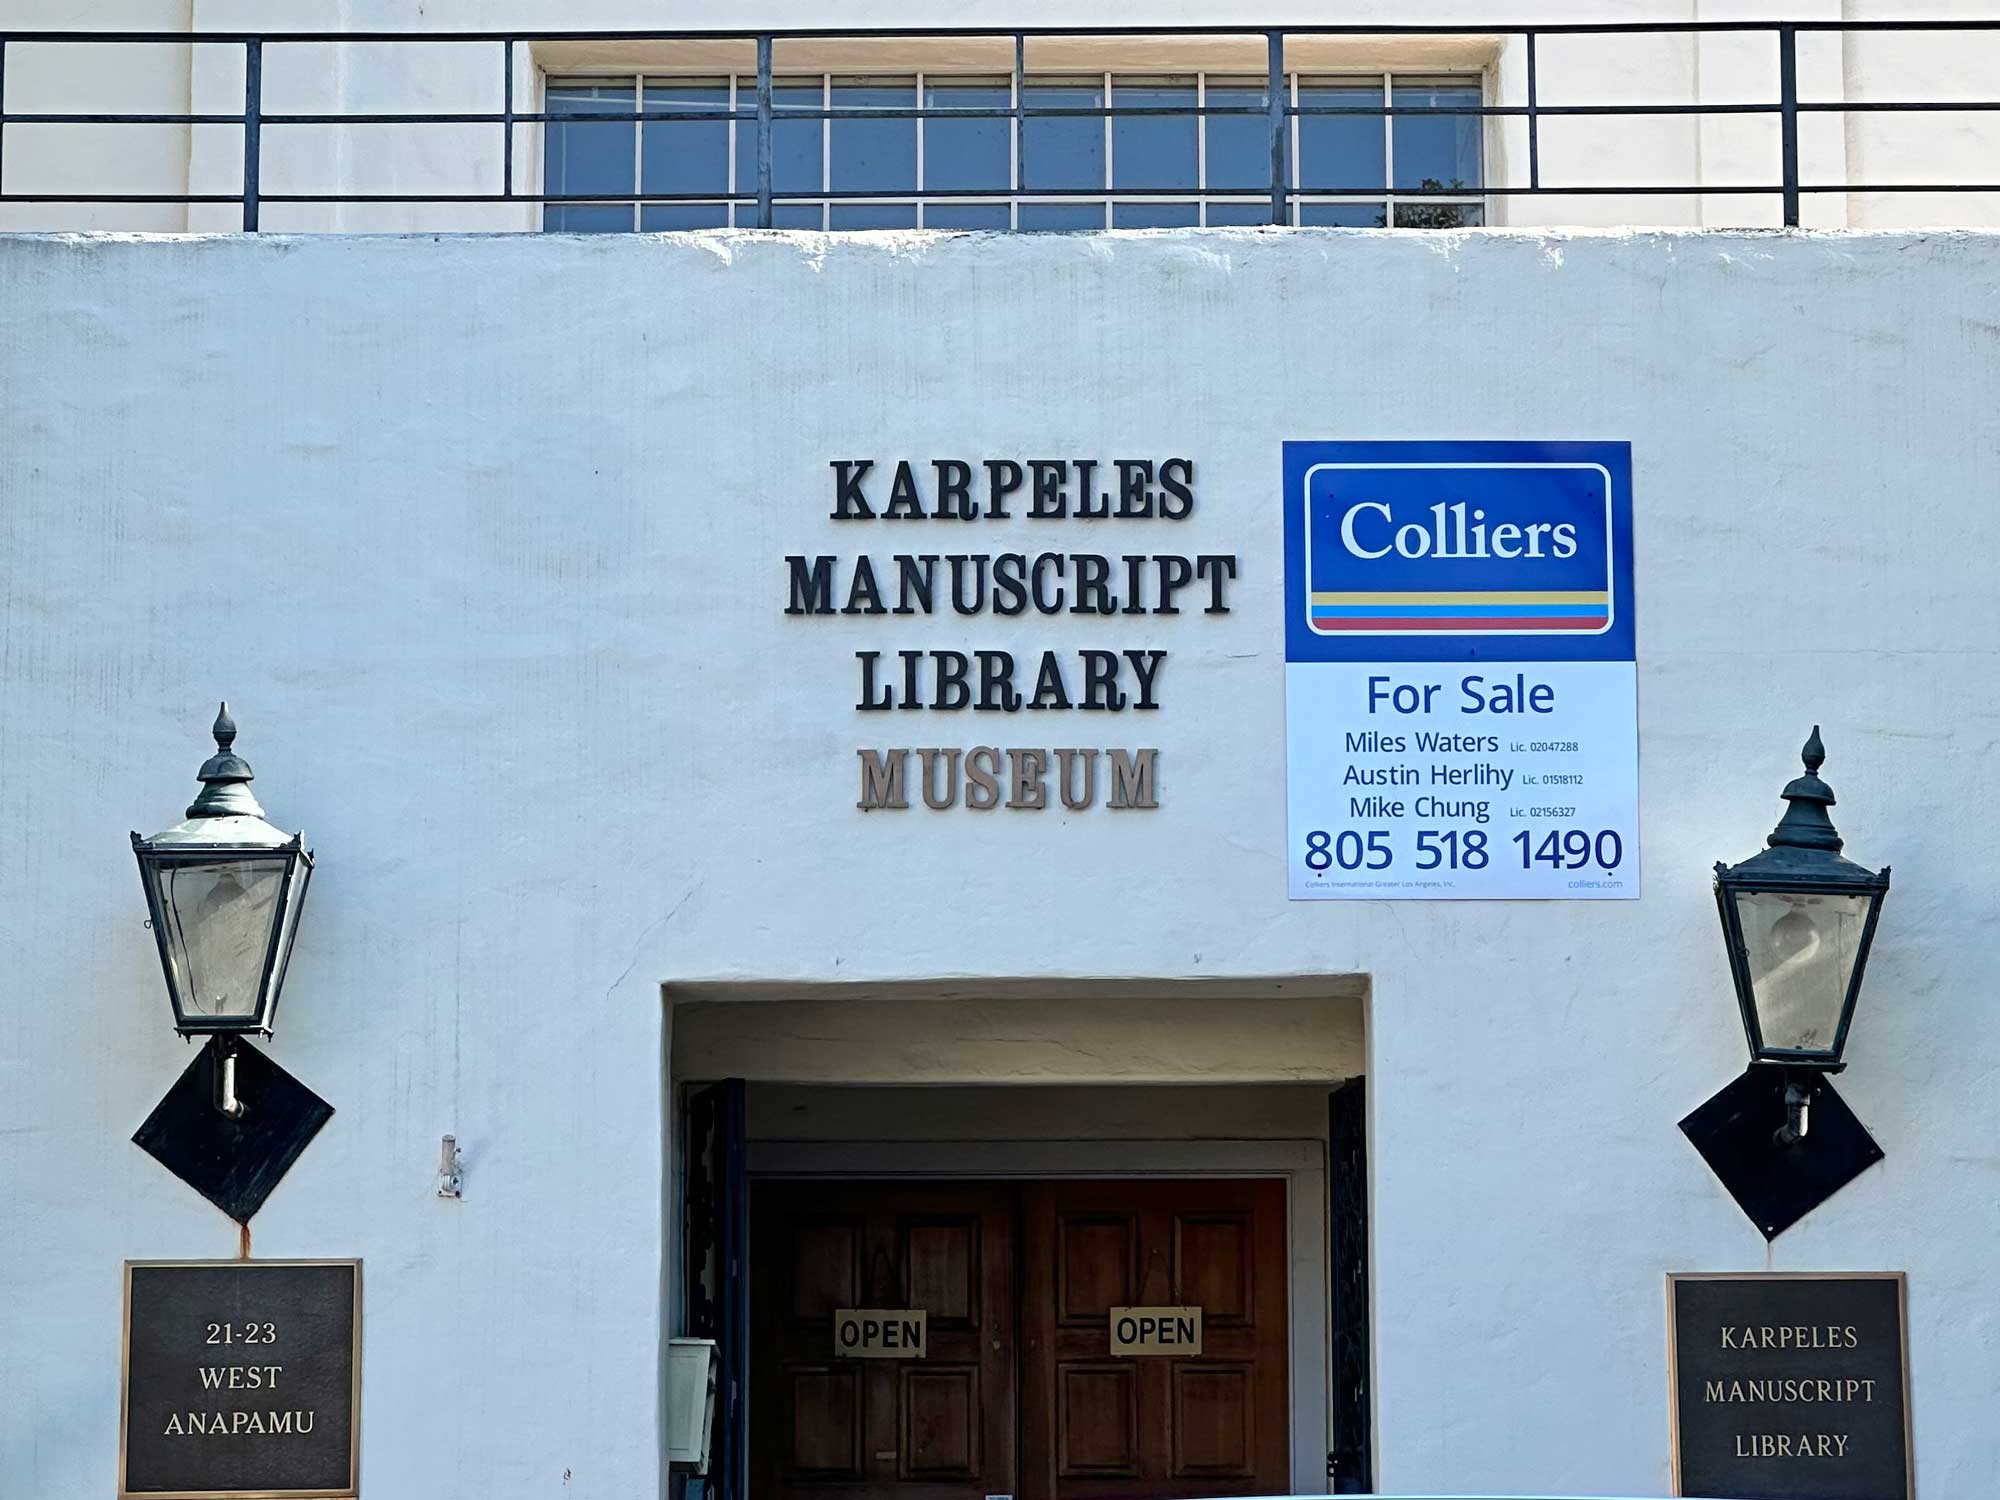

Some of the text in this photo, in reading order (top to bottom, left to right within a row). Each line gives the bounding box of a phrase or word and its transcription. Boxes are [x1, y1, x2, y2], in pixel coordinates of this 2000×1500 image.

[829, 458, 1194, 520] KARPELES
[1340, 501, 1577, 559] Colliers
[784, 552, 1237, 615] MANUSCRIPT
[855, 650, 1167, 711] LIBRARY
[1368, 674, 1554, 714] For Sale
[1345, 731, 1579, 752] Miles Waters Lic. 02047288
[856, 746, 1160, 809] MUSEUM
[1343, 763, 1583, 791] Austin Herlihy Lic. 01518112
[1350, 796, 1576, 824] Mike Chung Lic. 02156327
[1305, 829, 1622, 870] 805 518 1490
[1568, 880, 1623, 888] colliers.com
[206, 1323, 277, 1345] 21-23
[840, 1320, 921, 1348] OPEN
[1117, 1317, 1195, 1345] OPEN
[1721, 1326, 1858, 1349] KARPELES
[199, 1366, 282, 1390] WEST
[1705, 1380, 1876, 1402] MANUSCRIPT
[164, 1411, 315, 1435] ANAPAMU
[1736, 1435, 1848, 1457] LIBRARY
